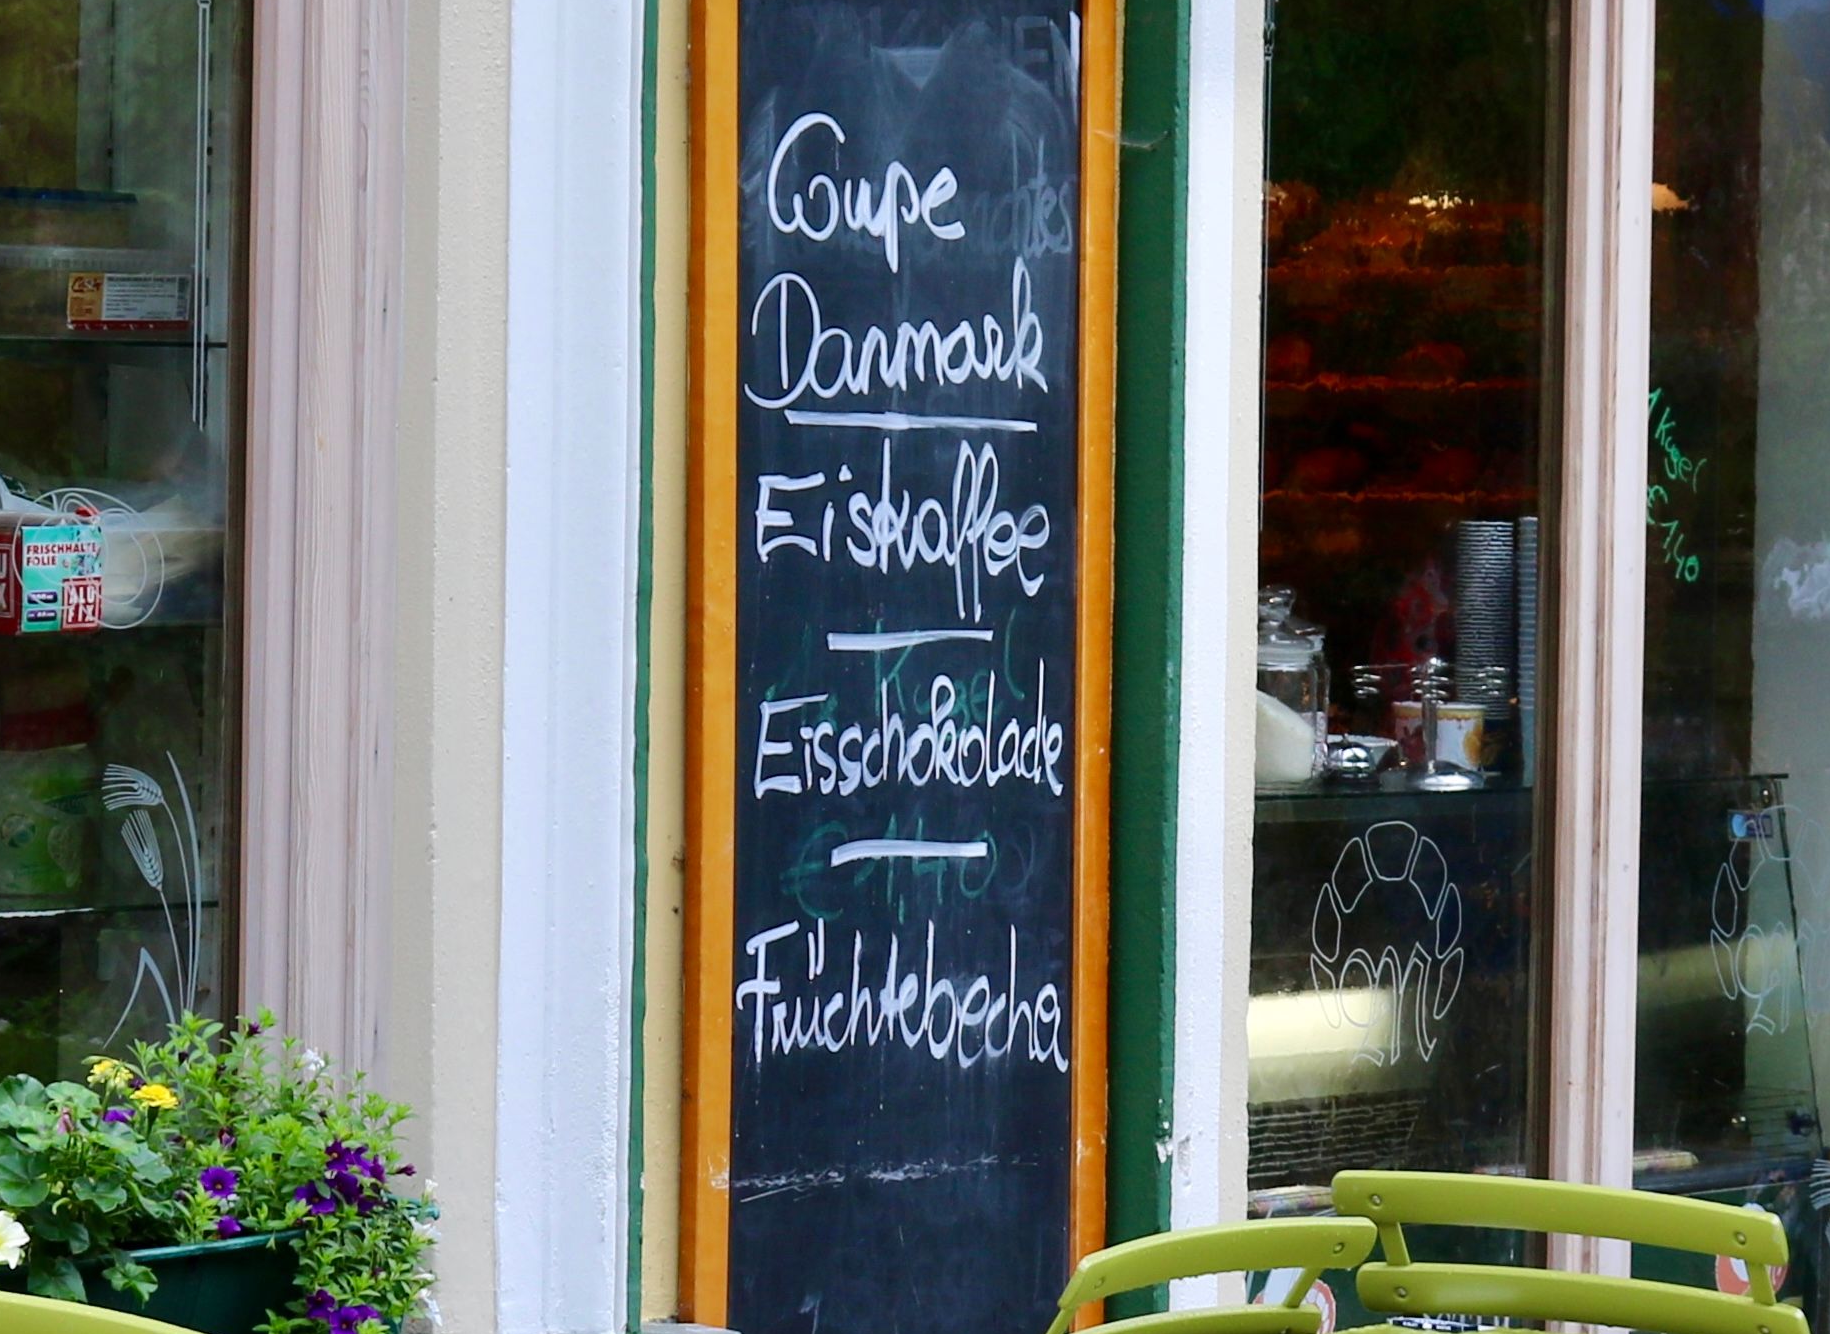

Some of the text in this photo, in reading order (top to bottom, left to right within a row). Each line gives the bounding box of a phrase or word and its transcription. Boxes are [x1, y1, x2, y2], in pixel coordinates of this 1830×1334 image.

[768, 112, 966, 274] Coupe
[743, 256, 1049, 409] Danmark
[26, 554, 58, 567] FOLIE
[69, 585, 96, 604] ALU
[754, 436, 1051, 624] Eiskaffee
[67, 604, 95, 623] FIX
[754, 657, 1064, 799] Eisschokolade
